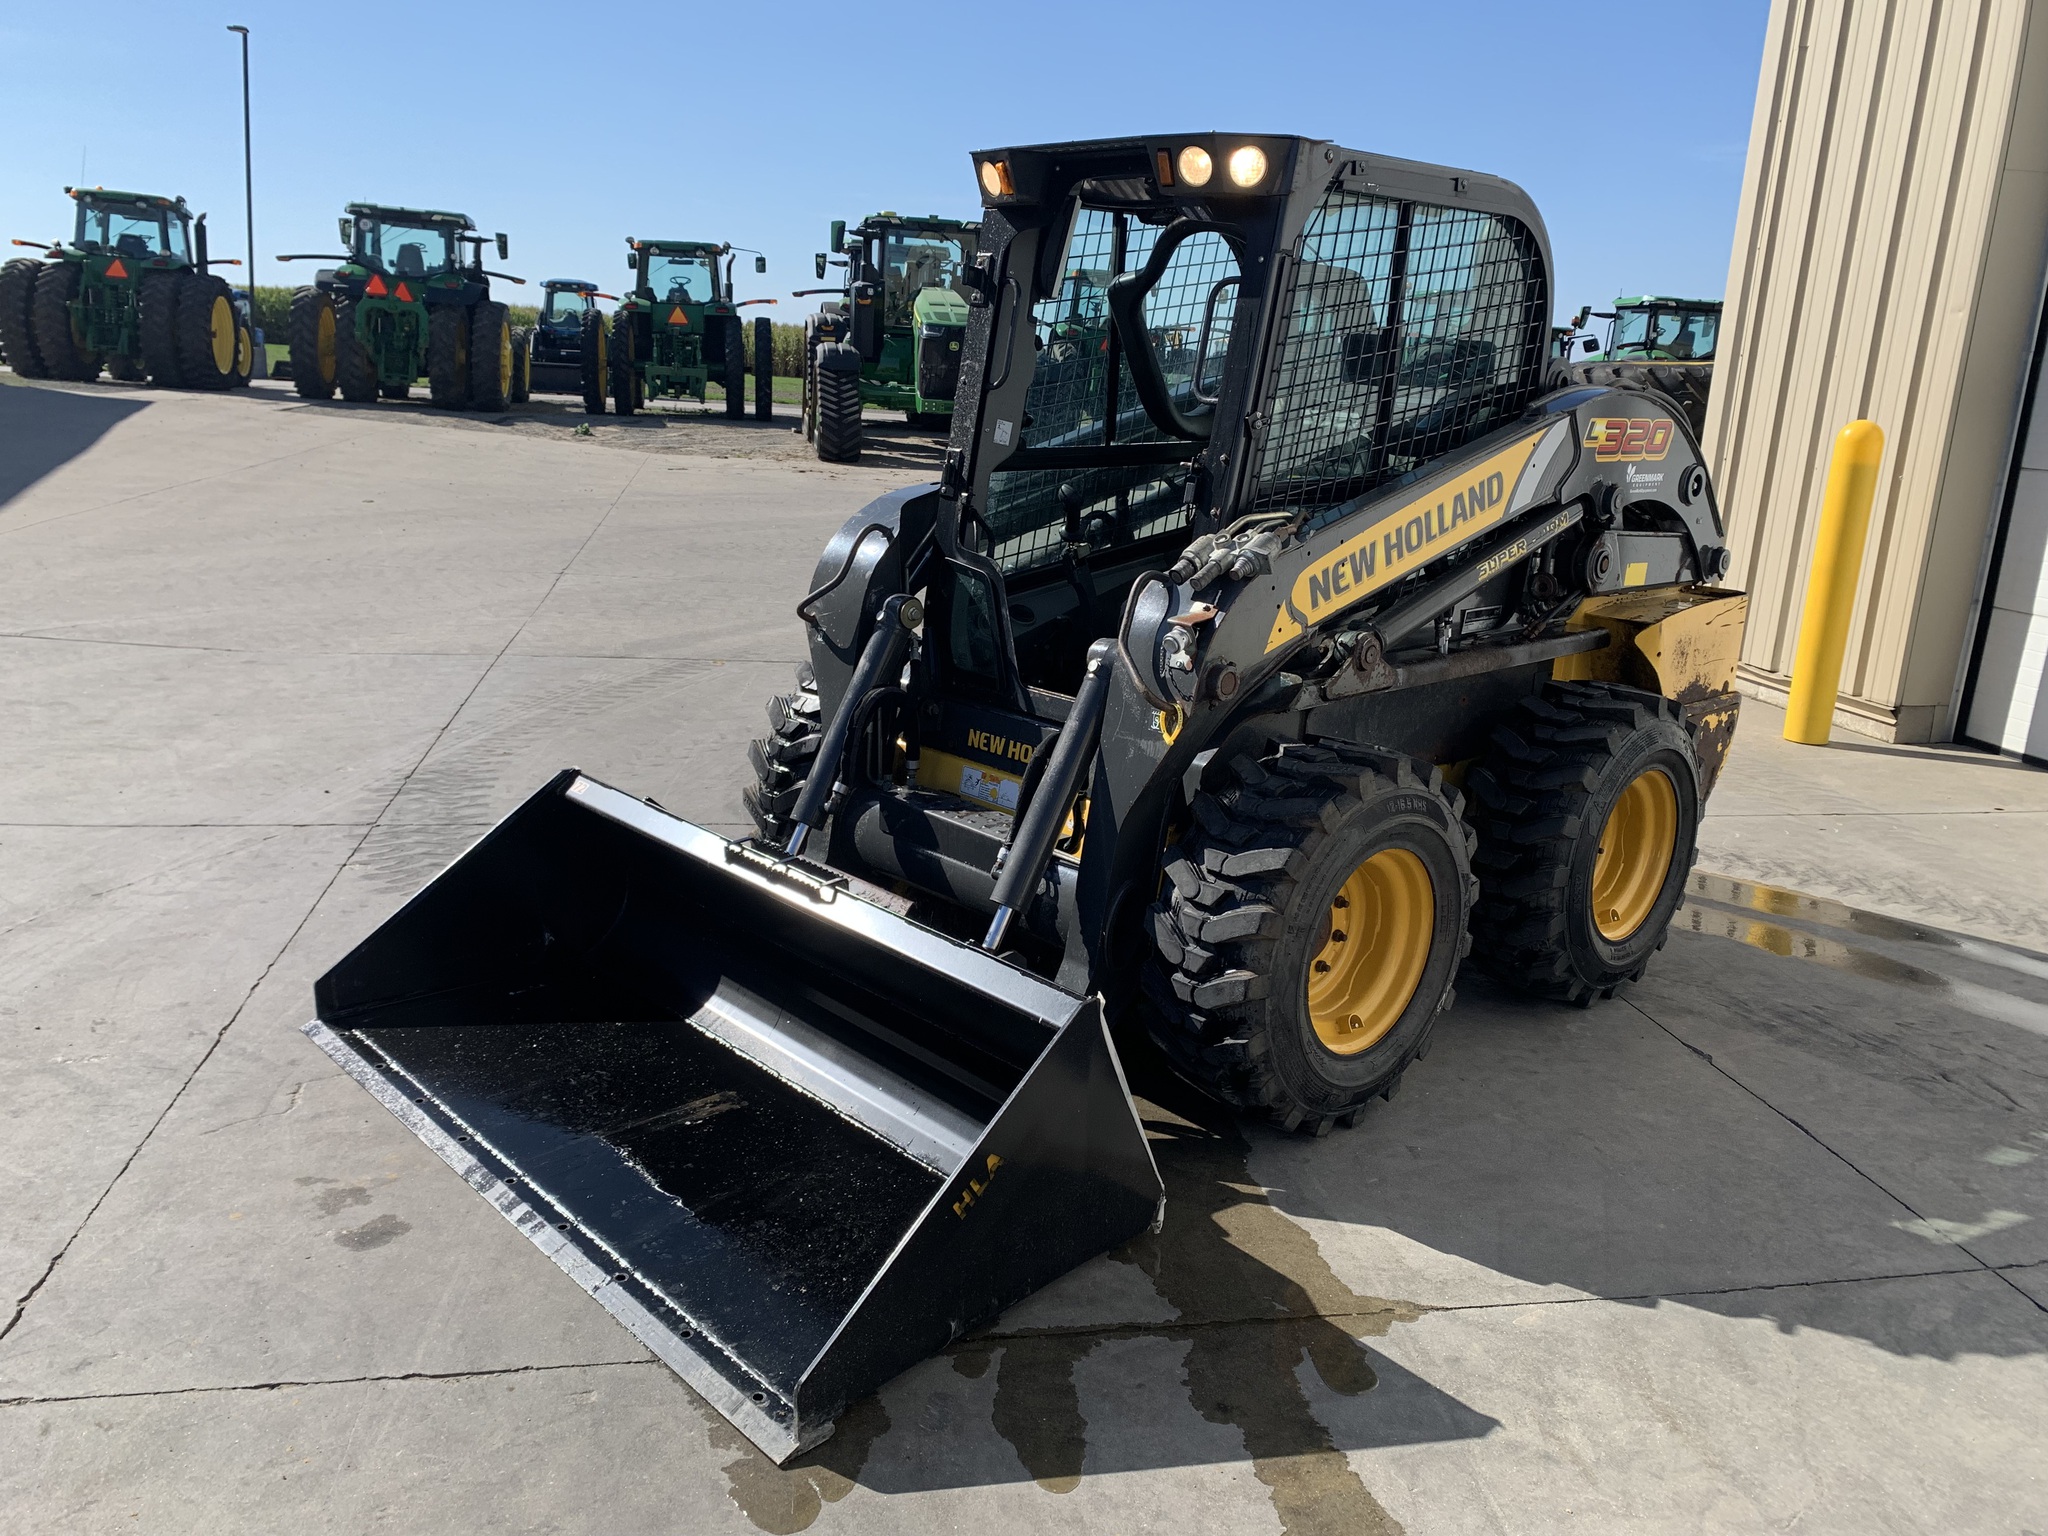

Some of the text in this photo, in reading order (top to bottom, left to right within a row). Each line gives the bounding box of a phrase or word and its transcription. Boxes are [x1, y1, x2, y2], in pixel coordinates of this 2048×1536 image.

[1583, 418, 1674, 462] L320
[1631, 473, 1664, 482] GREENMARK
[1308, 470, 1504, 611] NEW HOLLAND
[1476, 538, 1527, 582] SUPER
[967, 728, 1006, 755] NEW
[573, 780, 588, 793] 72
[953, 1153, 1005, 1220] HLA
